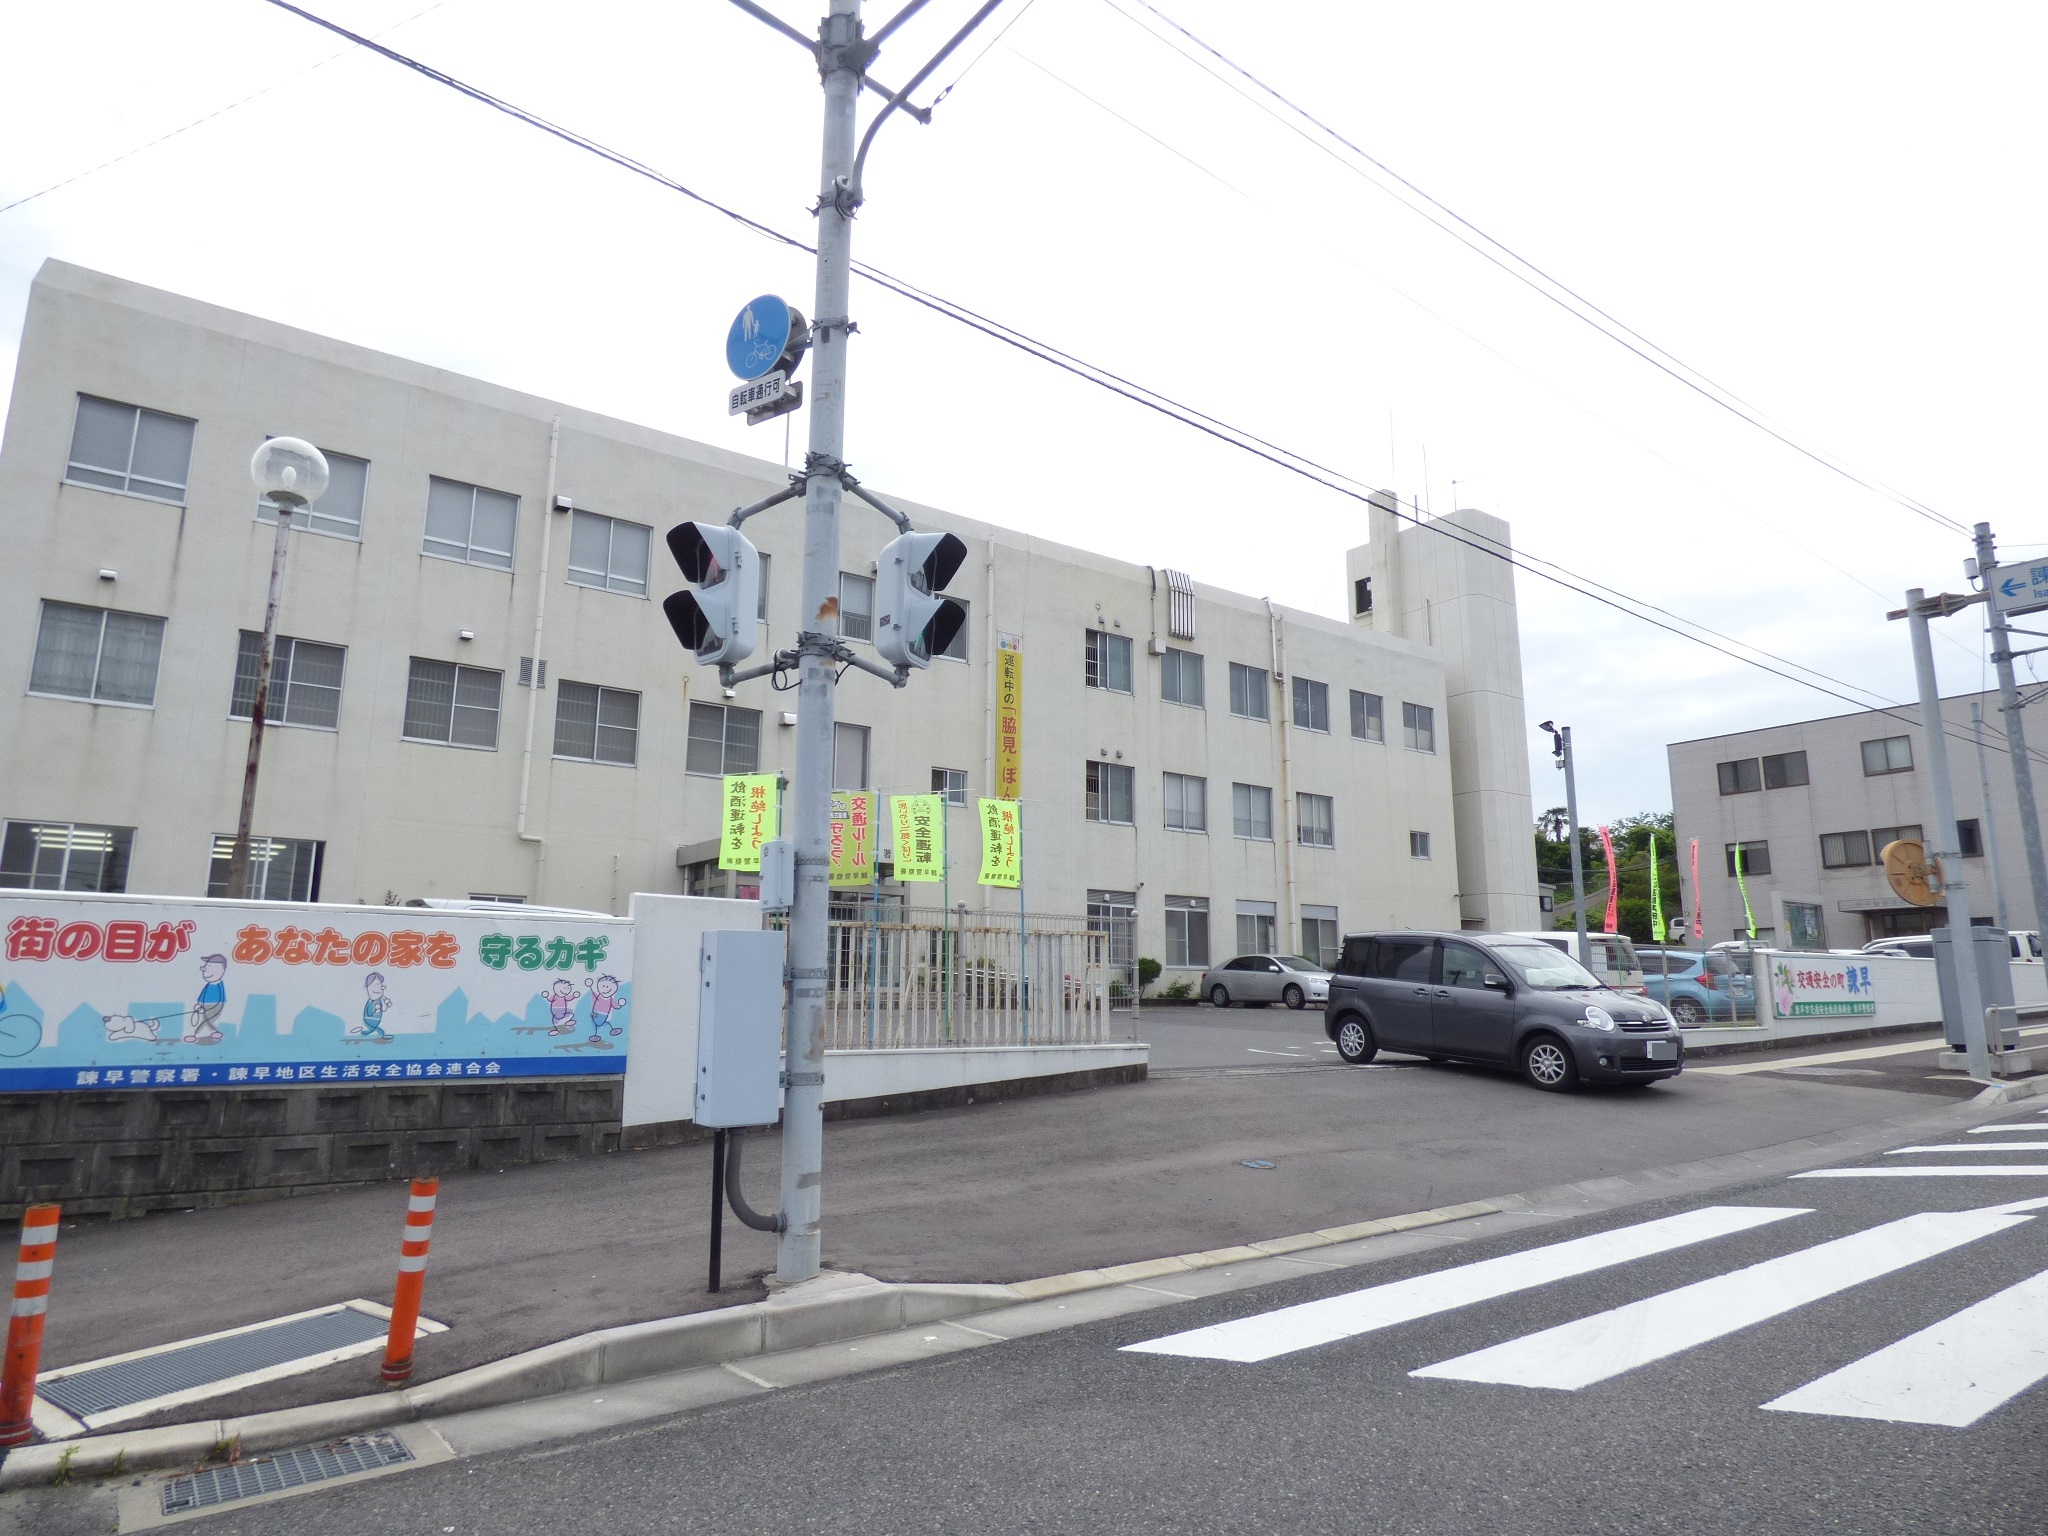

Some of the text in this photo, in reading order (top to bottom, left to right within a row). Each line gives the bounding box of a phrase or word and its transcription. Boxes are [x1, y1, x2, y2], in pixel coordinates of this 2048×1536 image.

[732, 378, 780, 409] 自転車通行可
[5, 915, 609, 972] 街の目が あなたの家を 守るカギ
[1796, 965, 1845, 990] 交通安全の町
